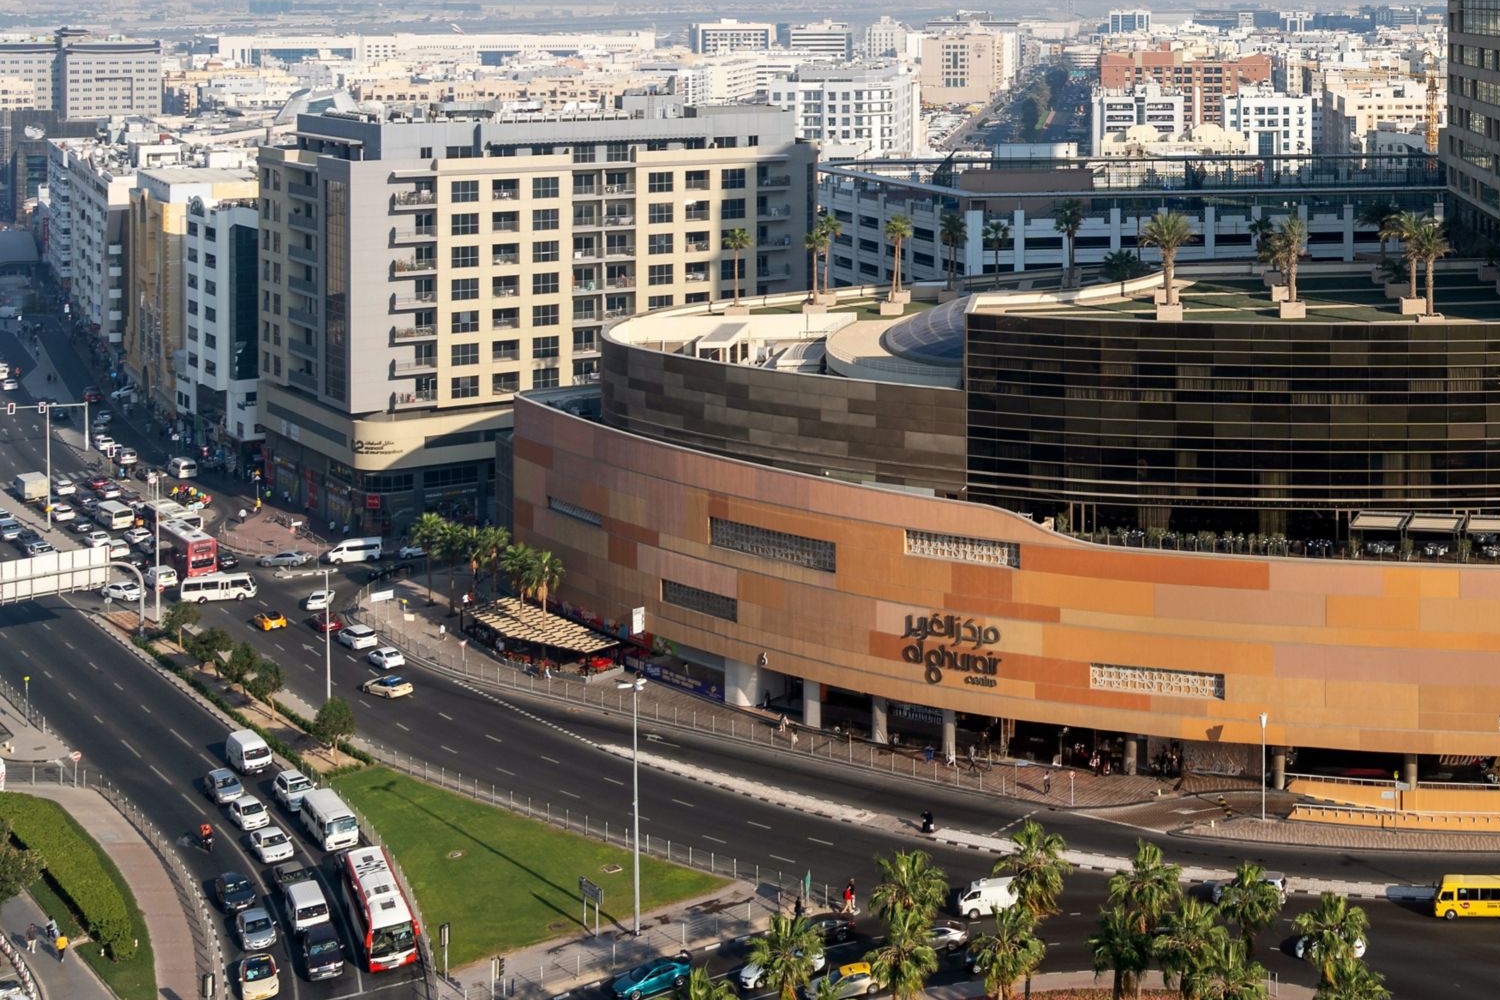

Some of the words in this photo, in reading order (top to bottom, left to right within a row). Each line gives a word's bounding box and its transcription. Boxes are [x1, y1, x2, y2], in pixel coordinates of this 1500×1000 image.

[900, 613, 955, 641] الغرير
[950, 617, 1001, 651] مركز
[902, 639, 925, 665] al
[924, 644, 1003, 685] ghurair
